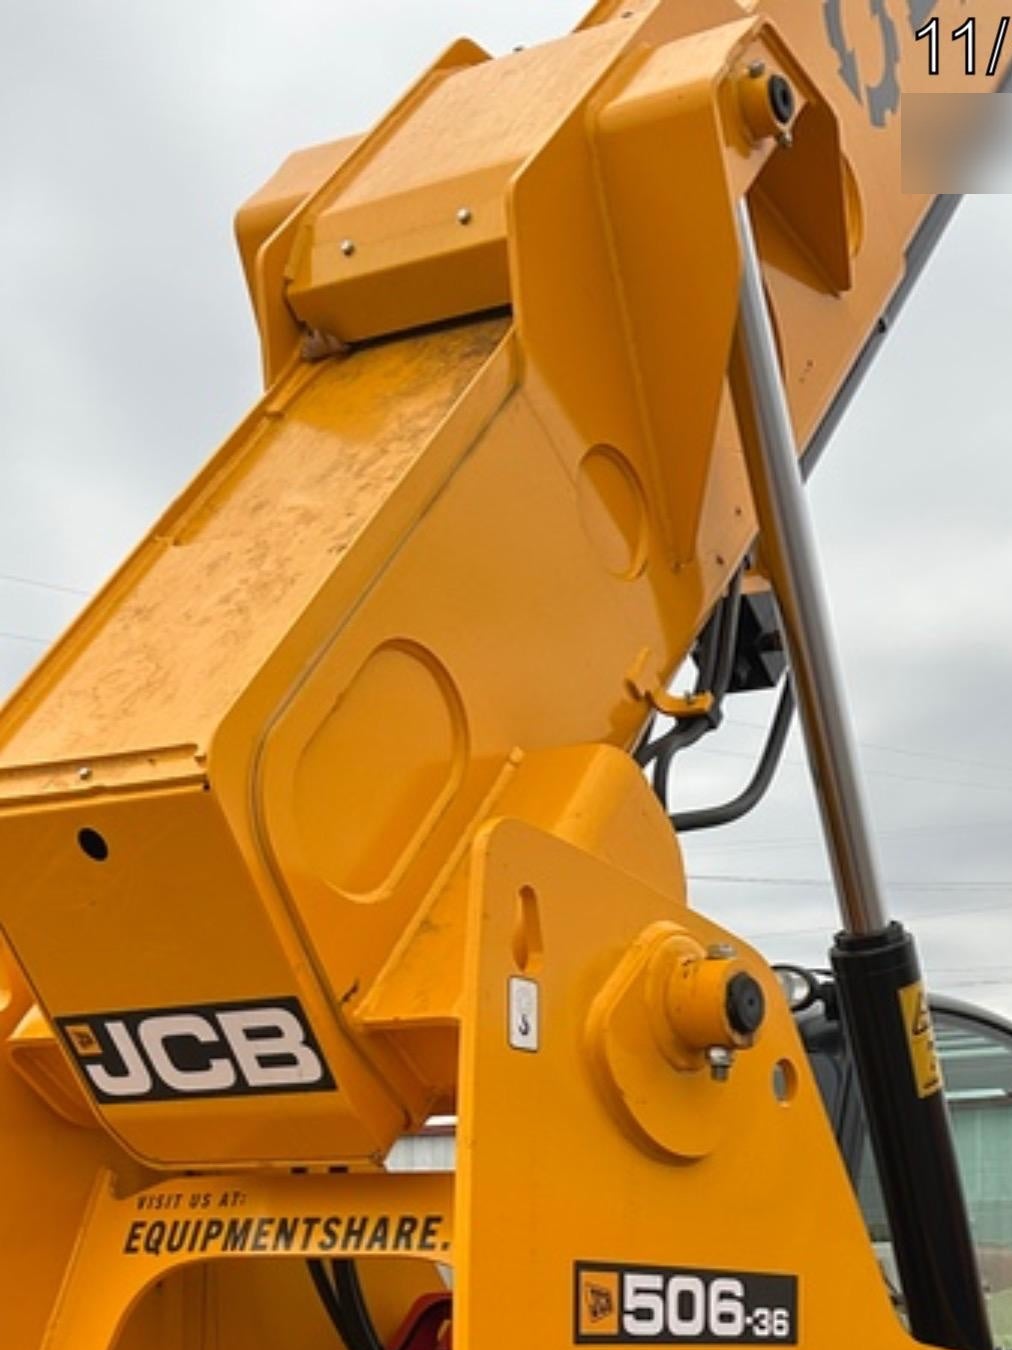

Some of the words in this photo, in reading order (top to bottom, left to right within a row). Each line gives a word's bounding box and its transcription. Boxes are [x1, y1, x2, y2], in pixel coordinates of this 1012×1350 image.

[85, 1008, 323, 1096] JCB
[137, 1194, 183, 1210] VISIT
[189, 1193, 212, 1209] US
[219, 1191, 247, 1207] AT:
